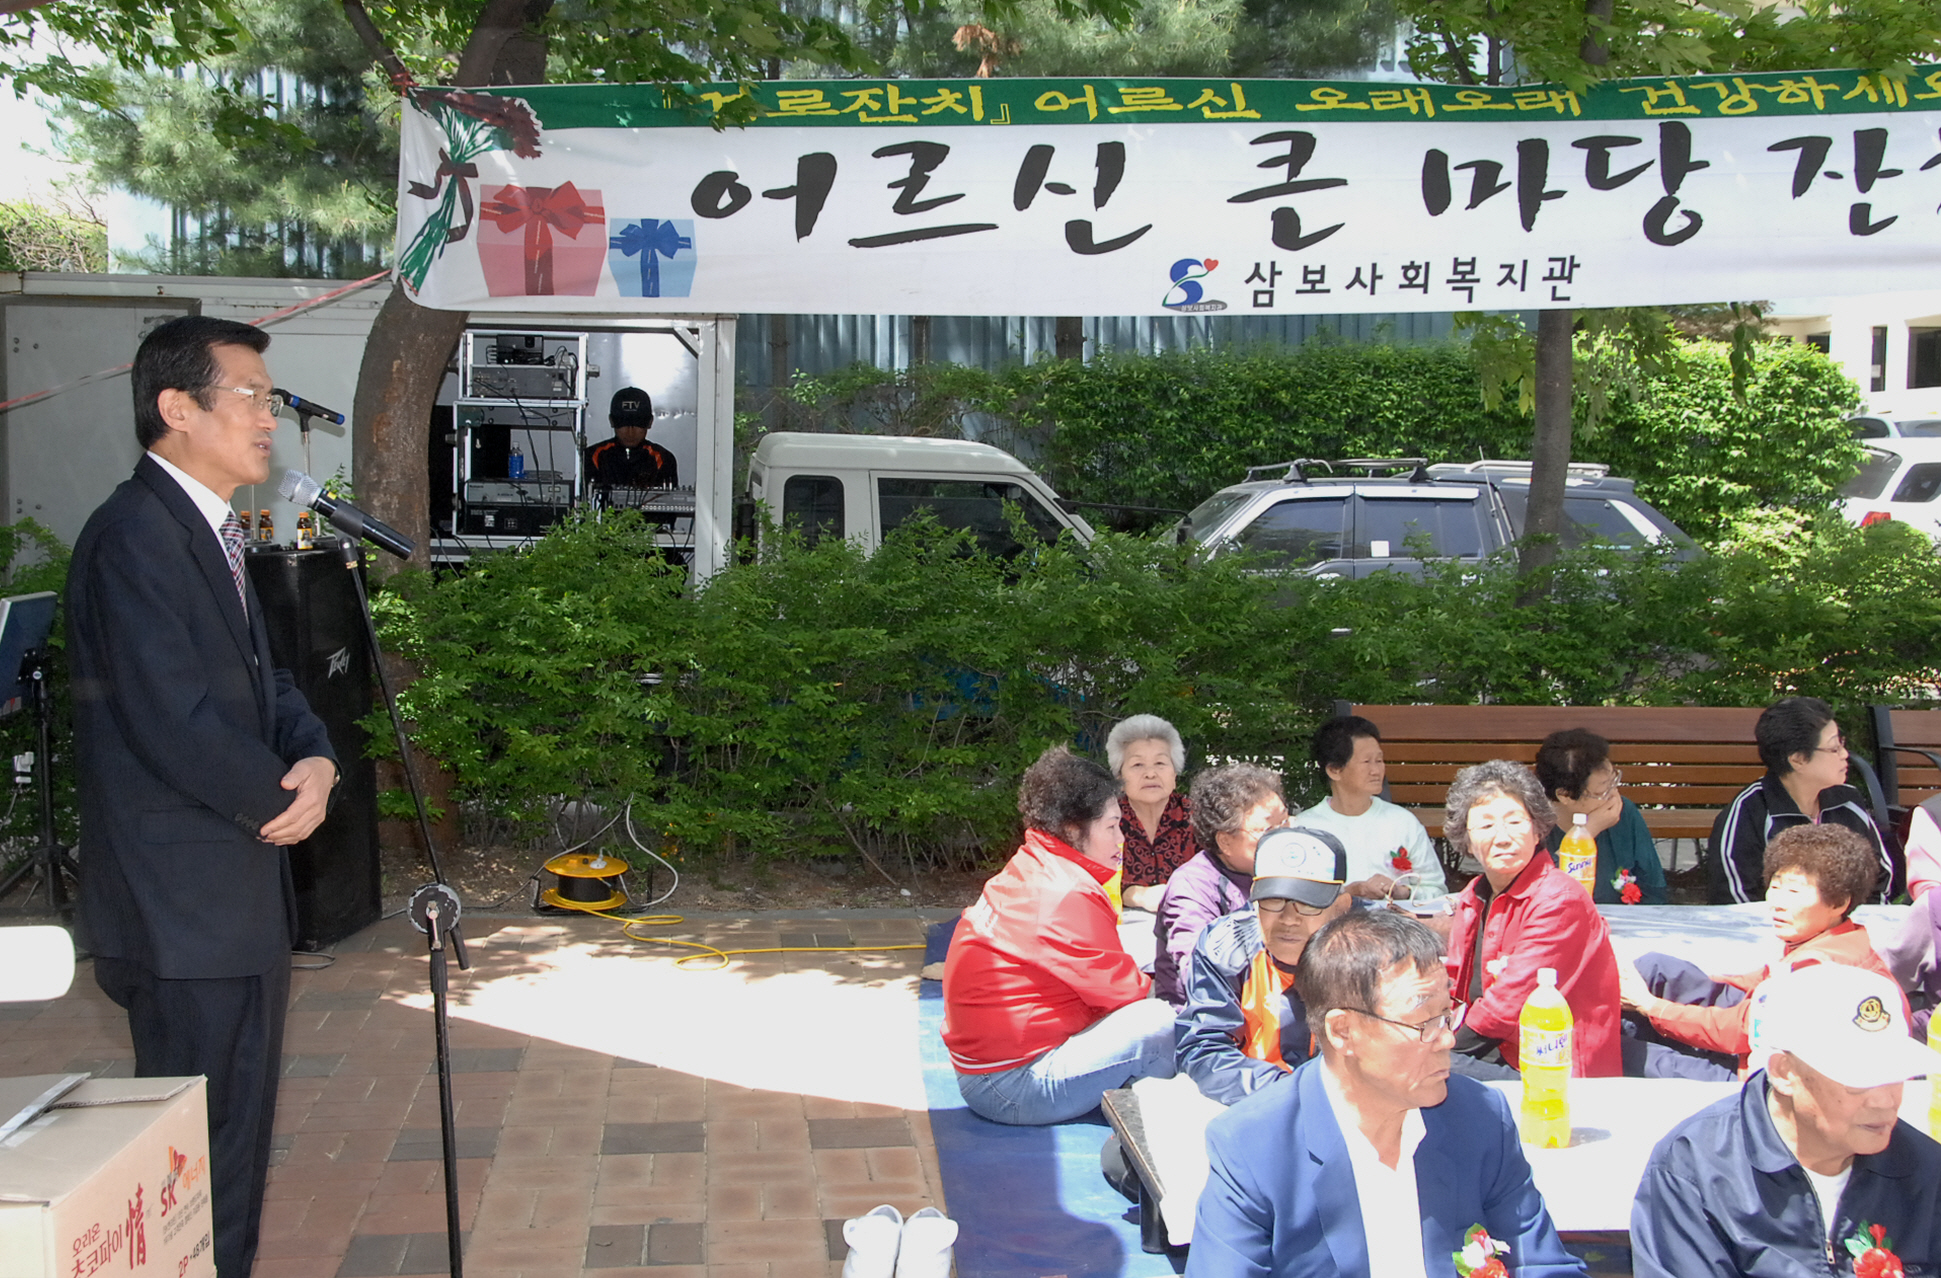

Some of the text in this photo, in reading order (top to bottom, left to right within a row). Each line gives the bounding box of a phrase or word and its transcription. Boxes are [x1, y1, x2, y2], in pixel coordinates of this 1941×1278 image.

[1034, 82, 1262, 121] 어르신
[1295, 86, 1581, 117] 오래오래
[690, 121, 1941, 255] 어르신 큰 마당 잔
[1243, 254, 1582, 309] 삼보사회복지관
[621, 400, 640, 411] FTV
[160, 1177, 177, 1218] SK
[72, 1222, 101, 1258] 오리온
